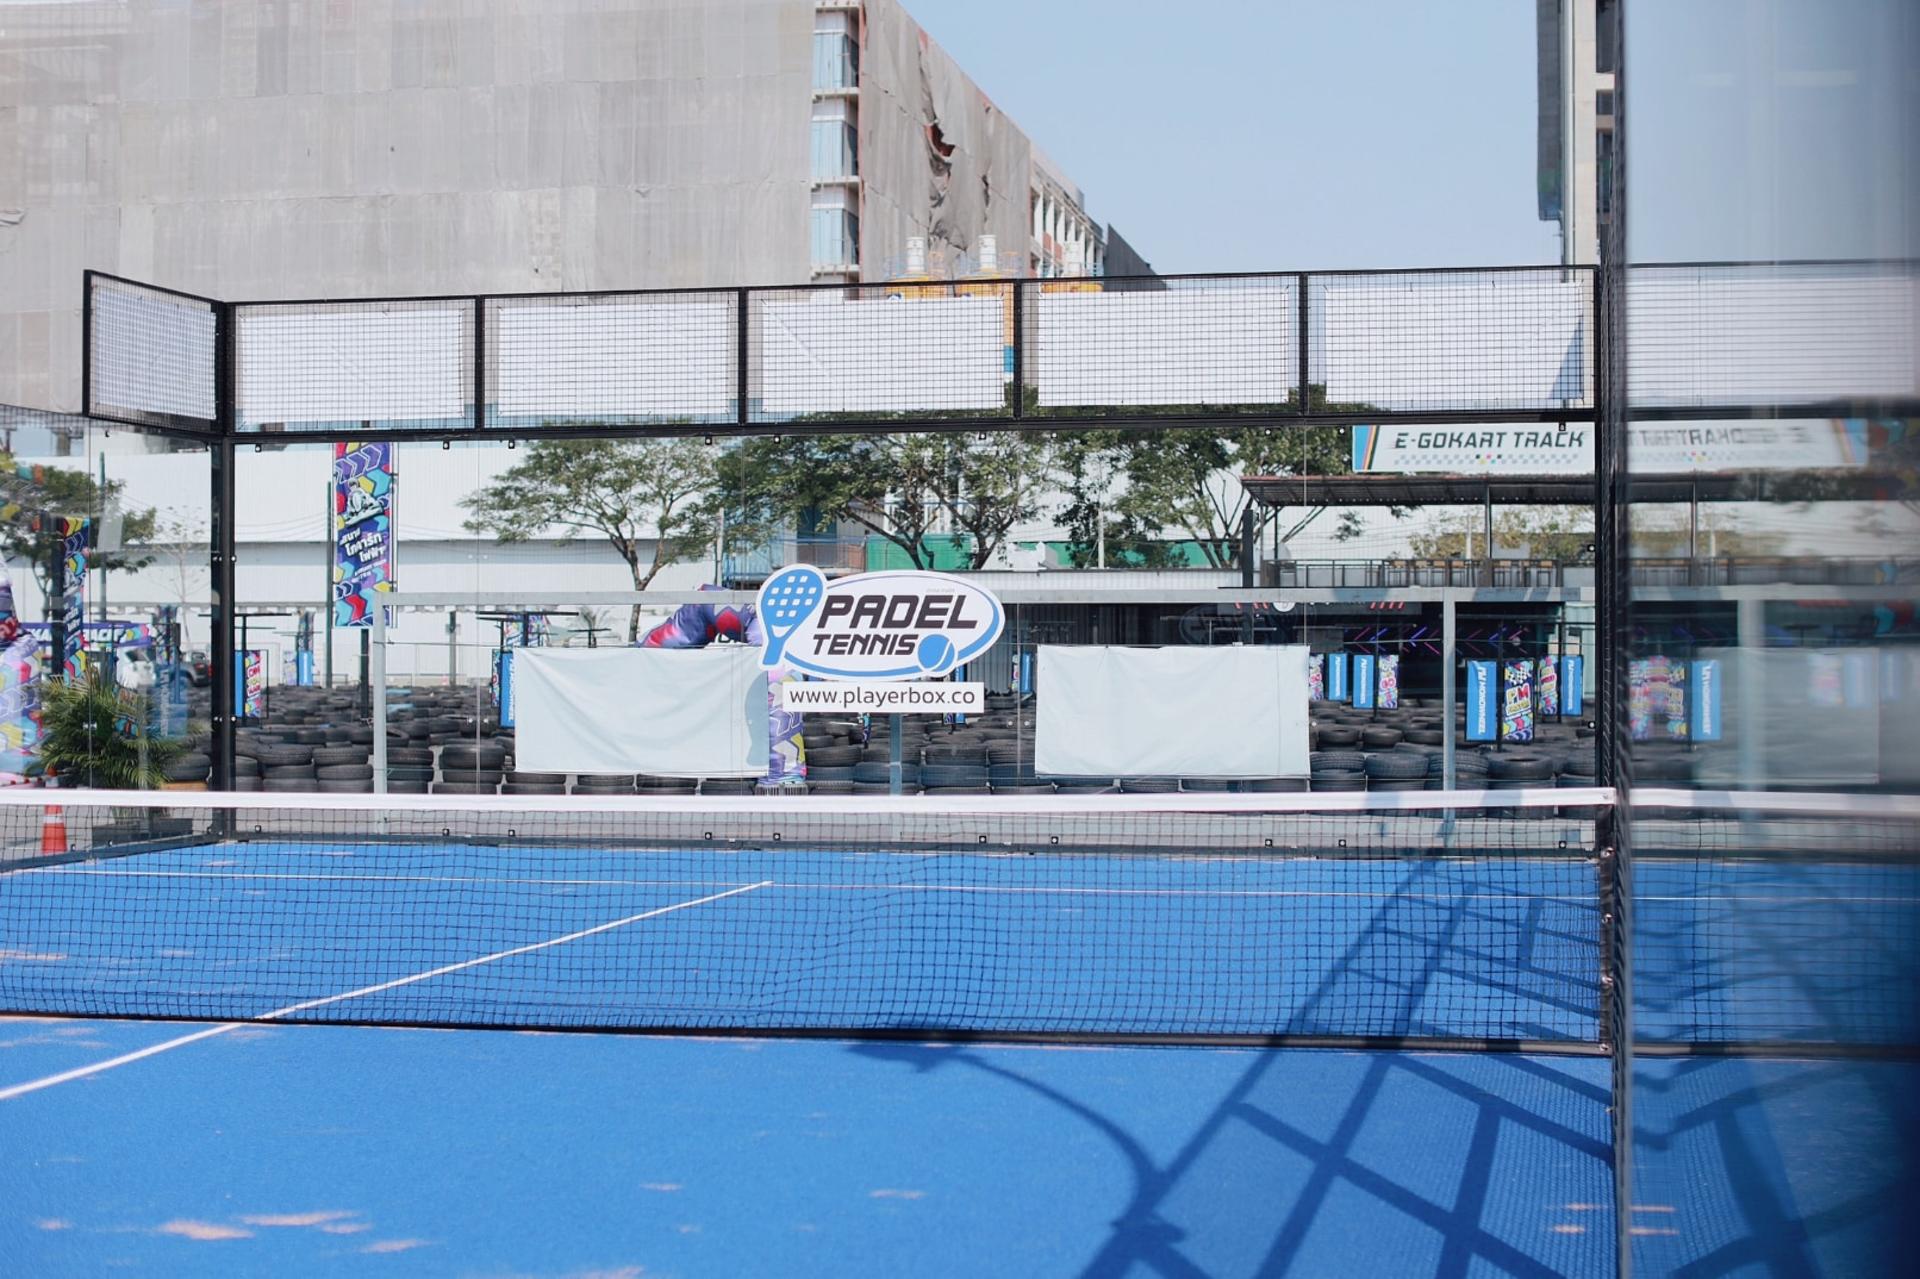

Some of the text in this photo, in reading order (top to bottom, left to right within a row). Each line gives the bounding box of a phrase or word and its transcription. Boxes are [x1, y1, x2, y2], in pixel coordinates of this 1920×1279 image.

[1395, 431, 1585, 449] E-GOKART TRACK
[816, 594, 978, 629] PADEL
[813, 634, 919, 655] TENNIS
[789, 686, 976, 708] www.playerbox.co
